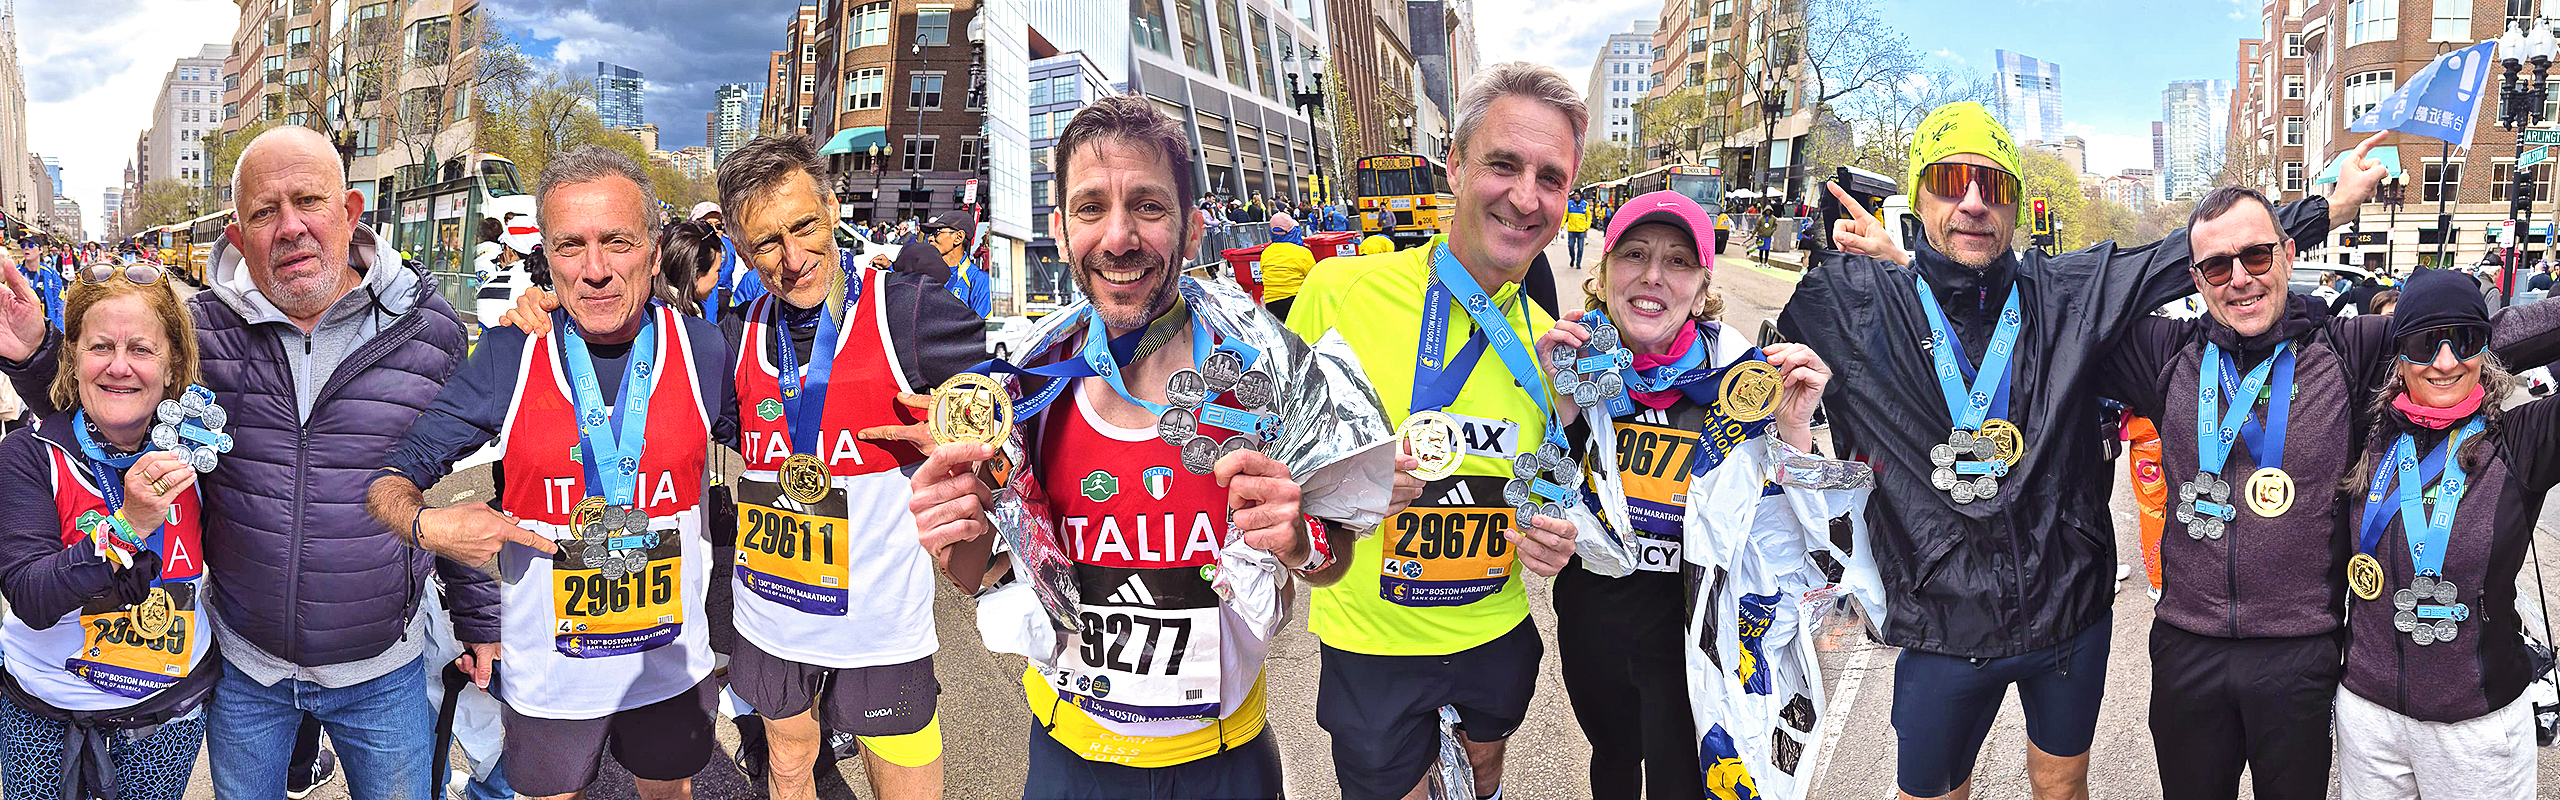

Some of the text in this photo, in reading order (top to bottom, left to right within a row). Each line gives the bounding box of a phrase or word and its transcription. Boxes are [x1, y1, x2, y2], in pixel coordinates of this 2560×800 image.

[1374, 158, 1411, 168] SCHOOL BUS
[744, 429, 865, 466] ITAIA
[1614, 427, 1698, 482] 9677
[1144, 468, 1172, 478] ITALIA
[543, 470, 678, 515] ITIA
[1644, 508, 1685, 522] MARATHON
[743, 509, 834, 565] 29611
[1060, 511, 1222, 562] ITALIA
[1394, 512, 1509, 560] 29676
[738, 552, 747, 563] 4
[1386, 560, 1399, 573] 4
[564, 563, 672, 617] 29615
[771, 582, 796, 596] BOSTON
[796, 587, 837, 603] MARATHON
[1429, 587, 1460, 596] BOSTON
[558, 620, 571, 633] 4
[602, 637, 633, 645] BOSTON
[634, 627, 671, 643] MARATHON
[1079, 611, 1192, 676] 9277
[109, 673, 138, 686] BOSTON
[1057, 670, 1070, 686] 3
[116, 683, 142, 693] AMERICA
[1108, 708, 1147, 723] BOSTON
[1099, 733, 1155, 745] COMP
[1089, 742, 1141, 756] RESS
[1081, 752, 1135, 764] PORT
